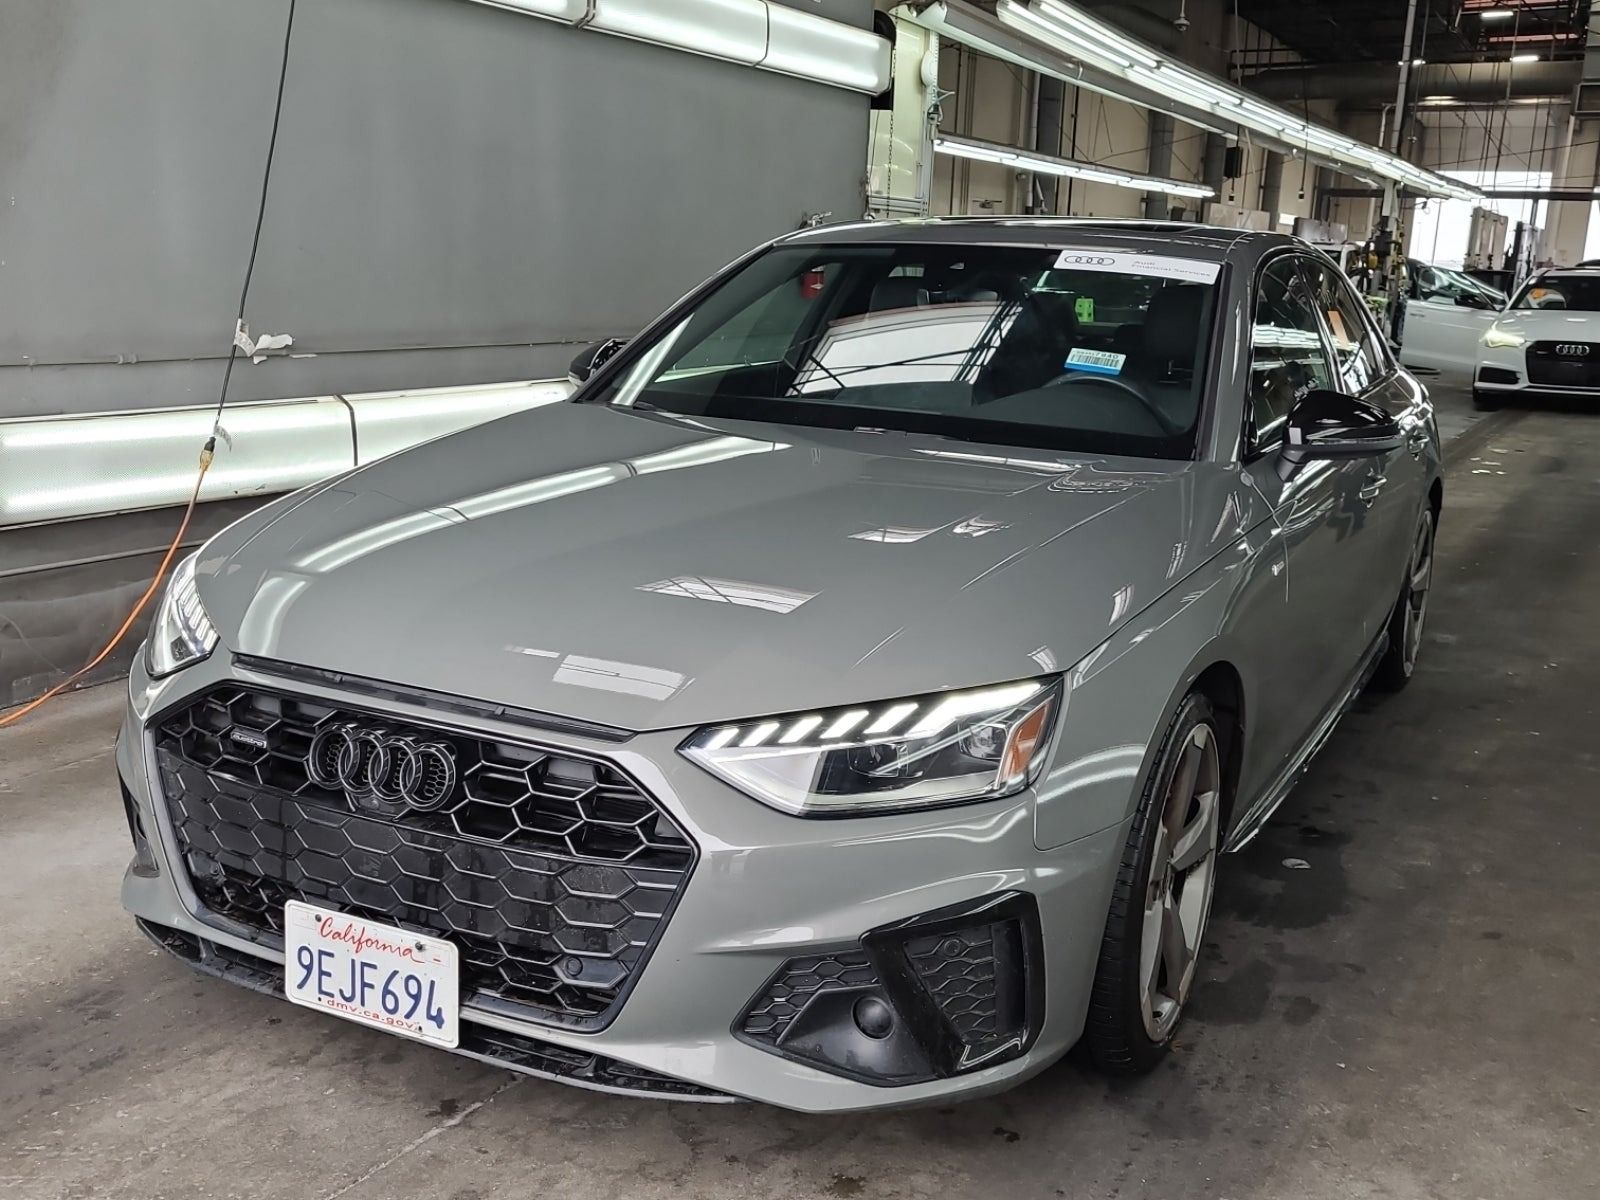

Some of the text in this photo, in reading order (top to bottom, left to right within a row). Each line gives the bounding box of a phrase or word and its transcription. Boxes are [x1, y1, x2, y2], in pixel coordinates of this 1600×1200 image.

[1174, 268, 1211, 277] Services
[320, 916, 425, 965] California
[296, 945, 445, 1030] 9EJF694
[326, 998, 414, 1029] dmv.ca.gov
